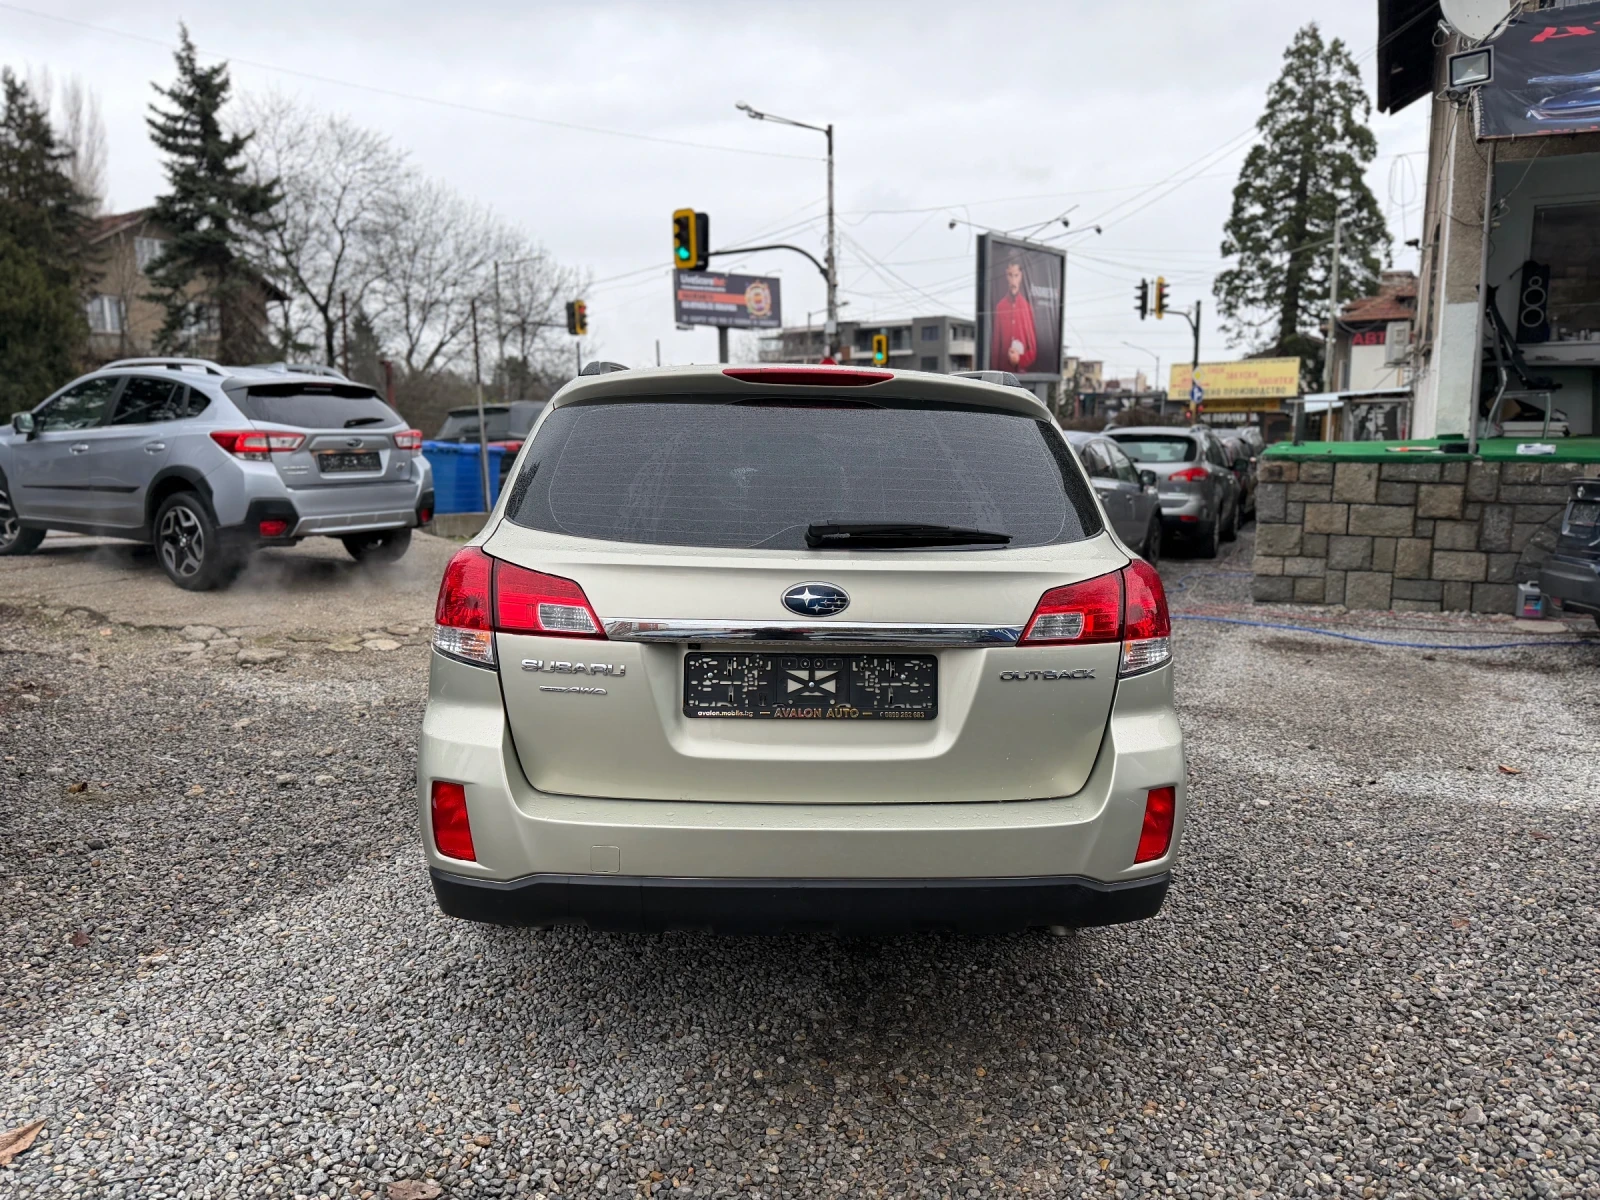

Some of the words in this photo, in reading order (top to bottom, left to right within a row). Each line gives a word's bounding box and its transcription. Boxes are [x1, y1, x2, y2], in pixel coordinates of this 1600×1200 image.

[521, 658, 626, 677] SUBARU
[999, 668, 1096, 681] OUTBACK
[773, 707, 822, 718] AVALON
[825, 707, 860, 718] AUTO
